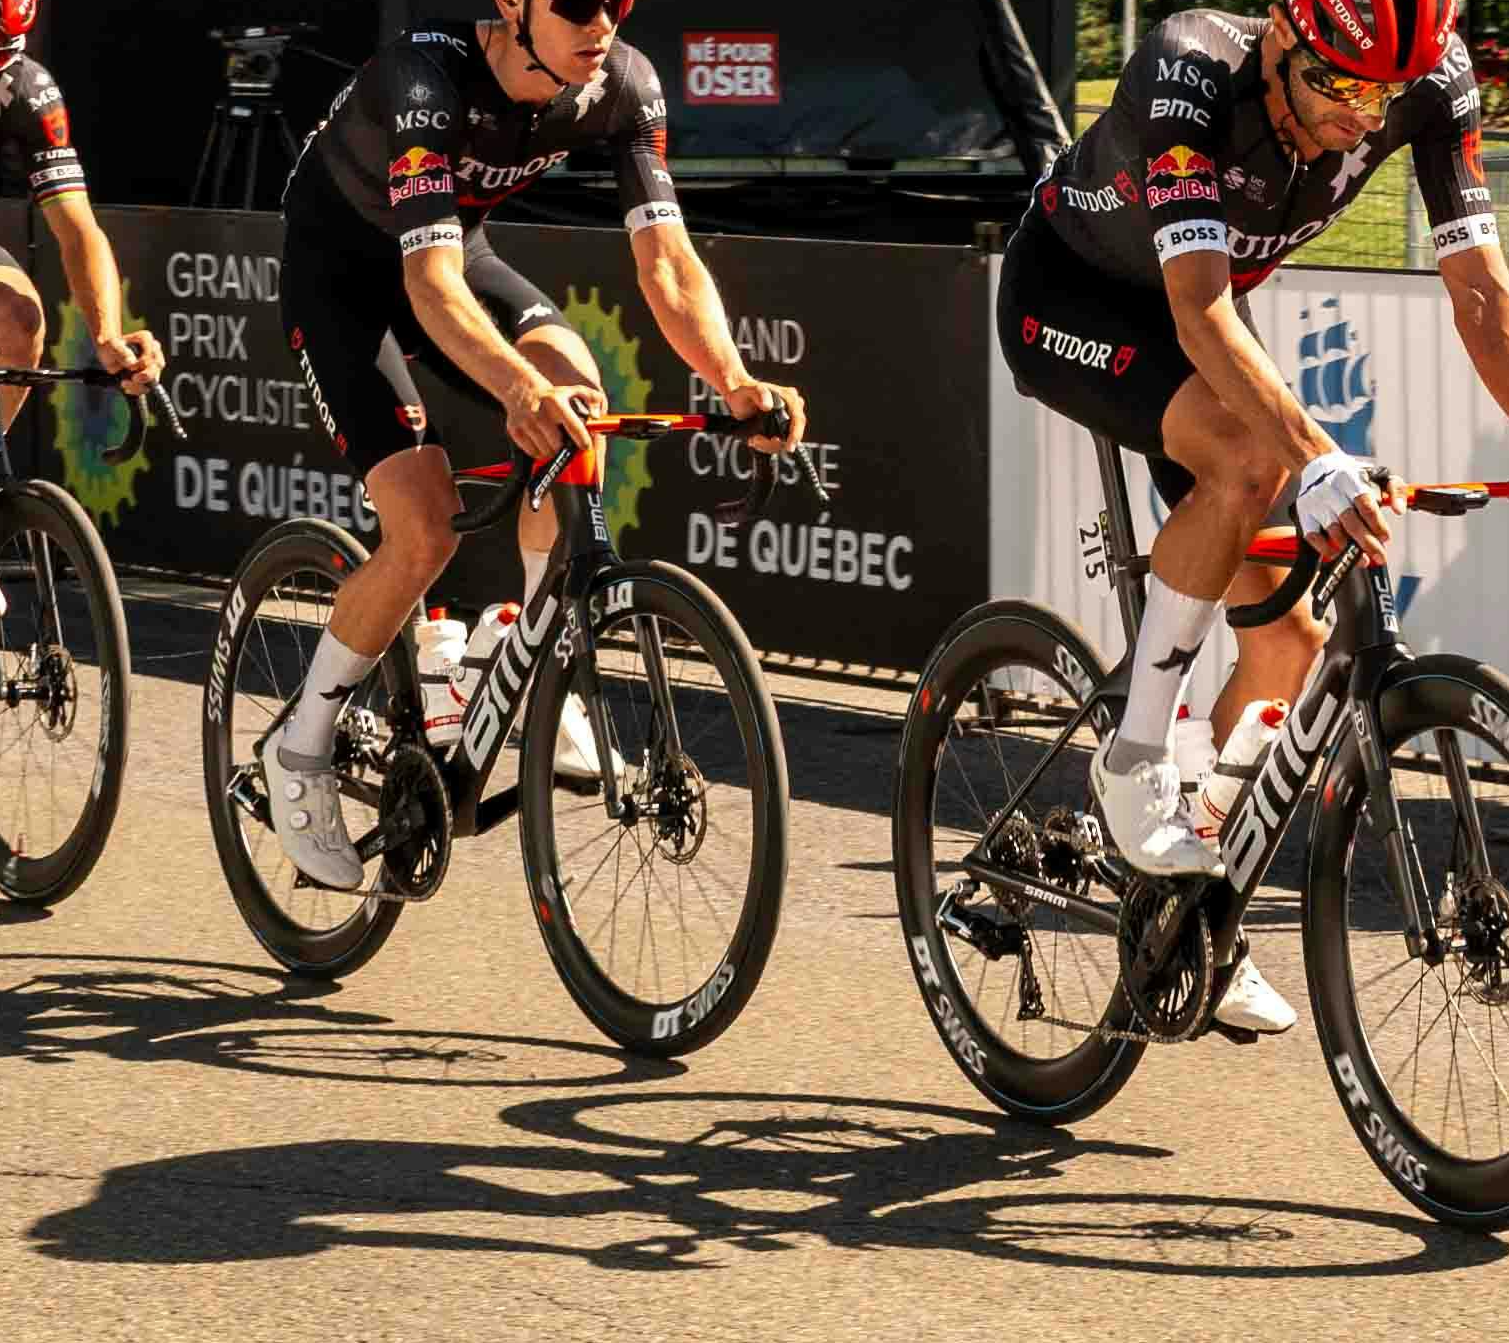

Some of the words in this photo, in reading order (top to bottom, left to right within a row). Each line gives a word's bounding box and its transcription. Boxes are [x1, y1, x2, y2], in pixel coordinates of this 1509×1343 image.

[411, 31, 468, 58] BMC
[688, 36, 715, 62] NÉ
[719, 42, 772, 62] POUR
[687, 66, 775, 98] OSER
[1155, 57, 1218, 100] MSC
[395, 108, 451, 133] MSC
[1150, 97, 1211, 128] BMC
[1063, 184, 1124, 212] TUDOR
[1147, 179, 1184, 210] Red
[1171, 226, 1218, 245] BOSS
[166, 252, 282, 303] GRAND
[169, 313, 248, 362] PRIX
[1042, 326, 1113, 370] TUDOR
[170, 371, 311, 430] CYCLISTE
[299, 349, 336, 441] TUDOR
[174, 455, 230, 512] DE
[238, 453, 378, 533] QUÉBEC
[587, 492, 608, 542] BMC
[688, 512, 738, 570] DE
[748, 509, 913, 591] QUÉBEC
[1079, 520, 1107, 580] 215
[1318, 546, 1359, 600] SRAM
[226, 581, 247, 638] DT
[1374, 574, 1399, 634] BMC
[207, 630, 231, 725] SWISS
[463, 594, 558, 771] BMC
[1221, 691, 1339, 894] BMC
[1024, 884, 1068, 909] SRAM
[651, 1005, 684, 1039] DT
[685, 961, 736, 1029] SWISS
[912, 934, 940, 988] DT
[935, 993, 987, 1077] SWISS
[1334, 1053, 1371, 1109] DT
[1364, 1111, 1428, 1193] SWISS
